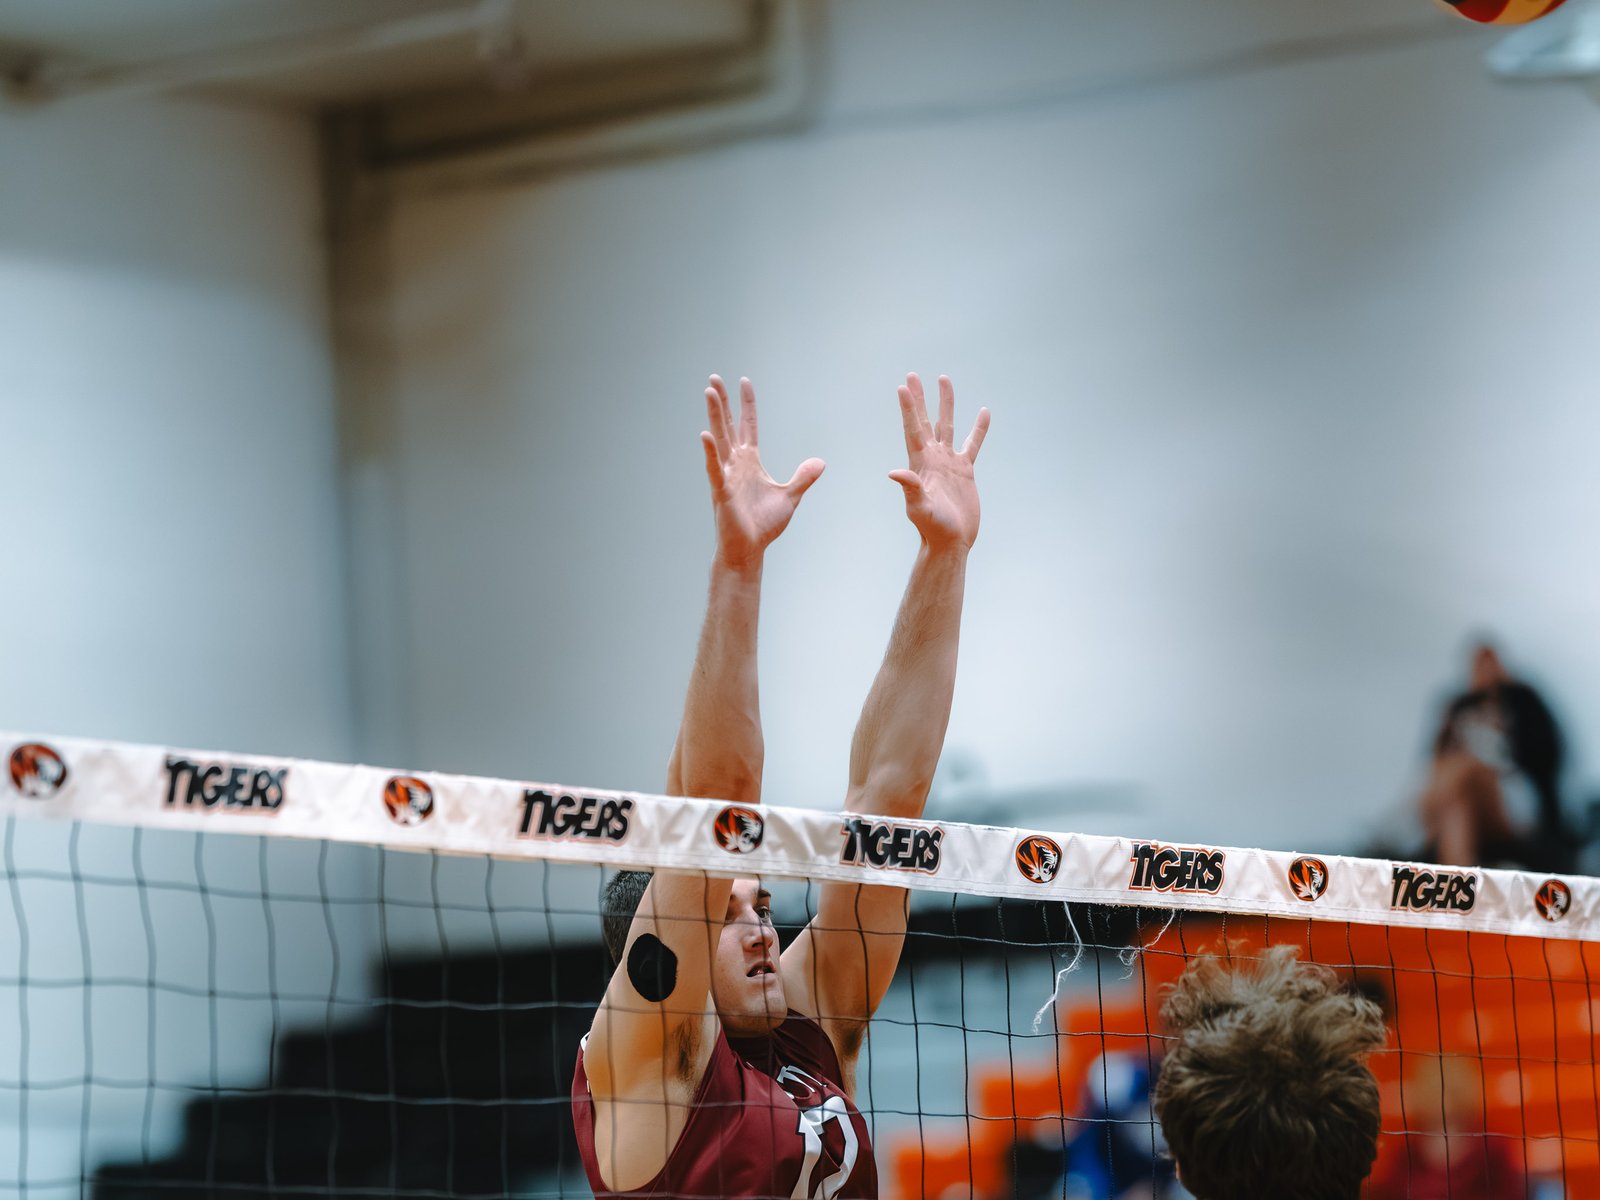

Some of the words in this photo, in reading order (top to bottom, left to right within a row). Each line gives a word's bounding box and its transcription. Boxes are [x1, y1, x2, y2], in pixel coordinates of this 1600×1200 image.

[164, 753, 290, 814] TIGERS
[517, 787, 637, 846] TIGERS
[840, 815, 946, 875] TIGERS
[1129, 841, 1226, 896] TIGERS
[1390, 863, 1477, 915] TIGERS
